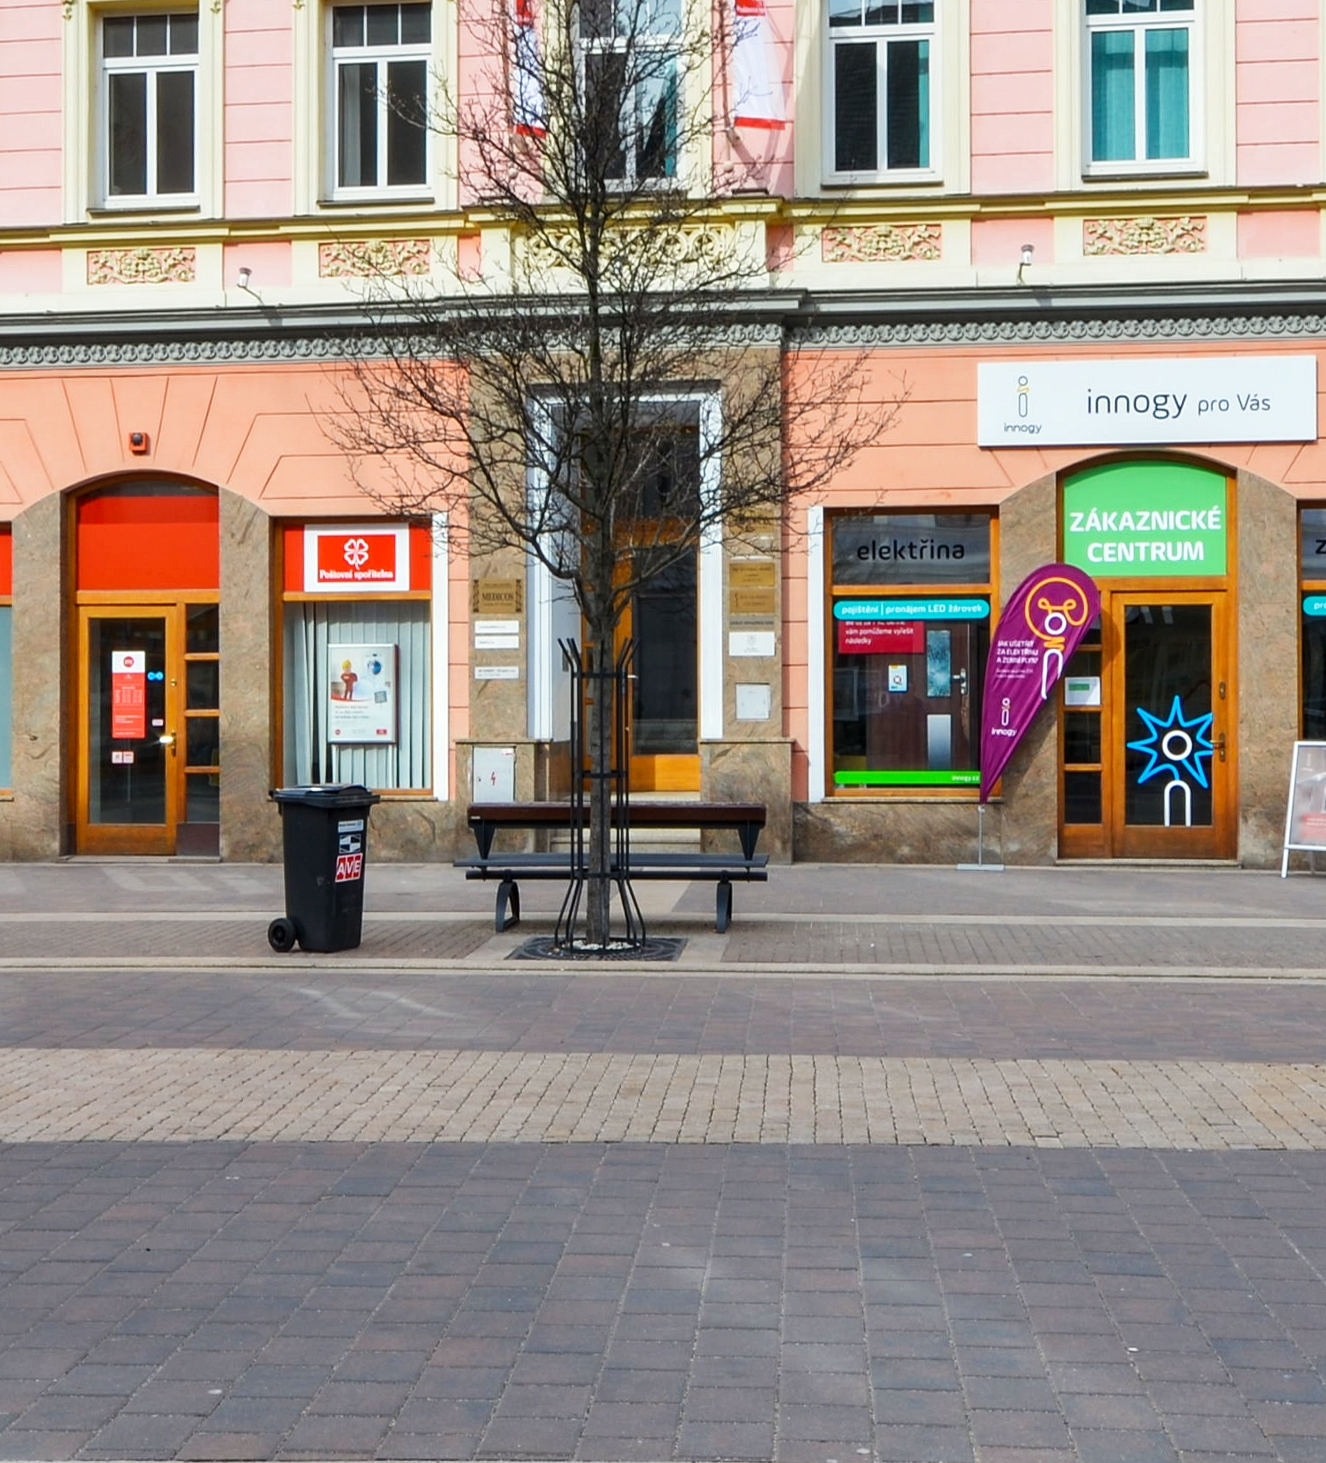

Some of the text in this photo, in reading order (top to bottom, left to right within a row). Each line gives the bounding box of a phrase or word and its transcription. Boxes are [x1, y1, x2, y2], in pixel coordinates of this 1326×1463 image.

[1087, 388, 1271, 419] innogy pro Vás
[1003, 422, 1042, 435] innogy
[1069, 505, 1222, 532] ZÁKAZNICKÉ
[857, 539, 965, 561] elektřina
[1087, 541, 1205, 562] CENTRUM
[319, 569, 394, 580] Poštovní spořitelna
[841, 604, 983, 616] pojištění pronájem LED žárovek
[991, 727, 1018, 738] innogy
[335, 858, 362, 878] AVE
